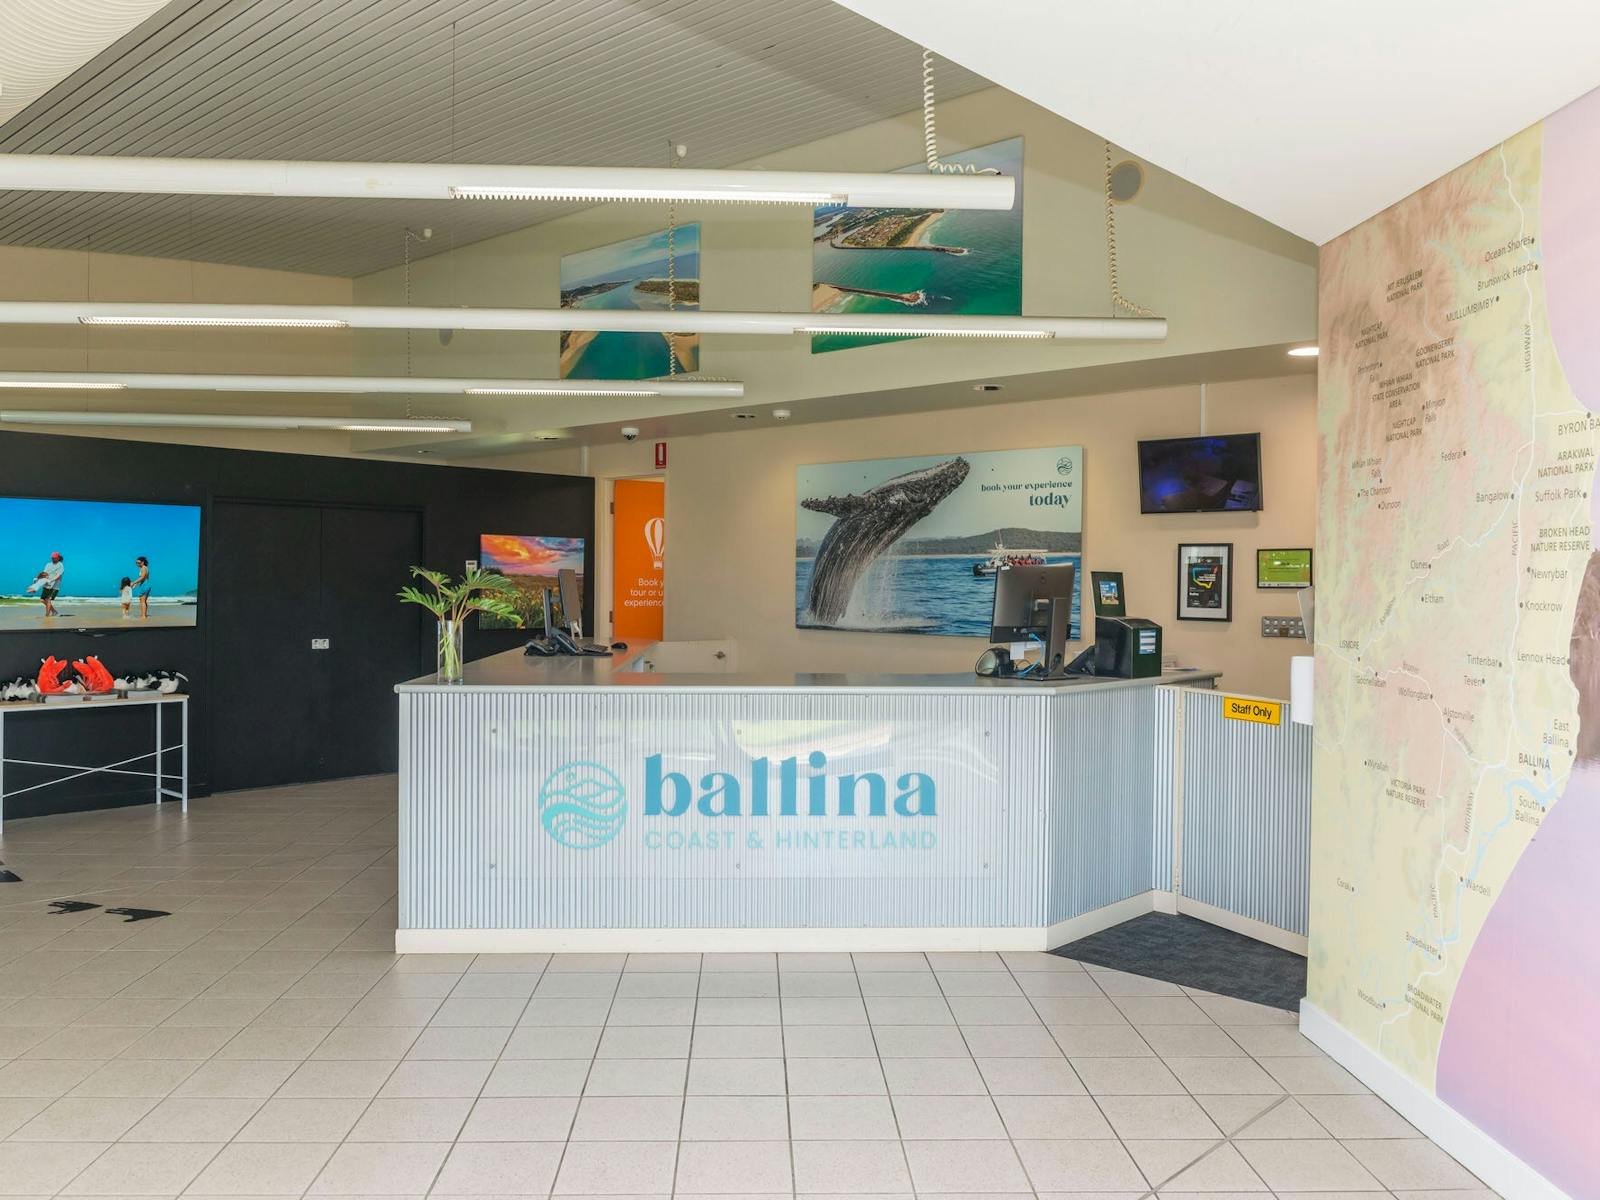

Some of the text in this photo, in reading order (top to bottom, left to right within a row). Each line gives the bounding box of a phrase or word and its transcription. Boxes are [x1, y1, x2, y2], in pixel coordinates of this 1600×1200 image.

[1485, 236, 1531, 262] Ocean Shores
[1397, 269, 1423, 287] JERUSALEM
[1477, 260, 1534, 291] Brunswick Heads
[1387, 281, 1423, 303] NATIONAL PARK
[1446, 296, 1495, 322] MULLUMBIMBY
[1355, 336, 1376, 349] NATIONAL
[1524, 324, 1532, 372] HIGHWAY
[1416, 350, 1455, 368] NATIONAL PARK
[1372, 382, 1421, 401] STATE CONSERVATION
[1389, 399, 1402, 408] AREA
[1393, 417, 1416, 429] NIGHTCAP
[1559, 421, 1587, 436] BYRON
[1386, 428, 1423, 441] NATIONAL PARK
[1441, 449, 1462, 461] Federal
[1558, 448, 1594, 461] ARAKWAL
[1538, 463, 1594, 479] NATIONAL PARK
[982, 481, 1072, 493] book your experience
[1030, 493, 1072, 508] today
[1476, 491, 1509, 503] Bangalow
[1536, 488, 1581, 502] Suffolk Park
[1539, 526, 1590, 538] BROKEN HEAD
[1531, 541, 1590, 552] NATURE RESERVE
[639, 578, 658, 587] Book
[1531, 569, 1567, 582] Newrybar
[631, 589, 646, 597] tour
[1525, 600, 1563, 612] Knockrow
[1468, 654, 1498, 667] Tintenbar
[1517, 652, 1566, 666] Lennox Head
[1464, 675, 1482, 687] Teven
[1232, 703, 1272, 719] Staff Only
[1554, 719, 1569, 732] East
[1544, 733, 1569, 748] Ballina
[1519, 753, 1550, 770] BALLINA
[643, 751, 937, 817] ballina
[1391, 779, 1426, 795] VICTORIA PARK
[1386, 789, 1426, 808] NATURE RESERVE
[1519, 796, 1540, 811] South
[1465, 793, 1474, 833] HIGHWAY
[1515, 809, 1539, 826] Ballina
[644, 830, 937, 850] COAST & HINTERLAND
[1466, 878, 1491, 897] Wardell
[1406, 932, 1438, 955] Broadwater
[1408, 984, 1442, 1010] BROADWATER
[1405, 994, 1444, 1024] NATIONAL PARK
